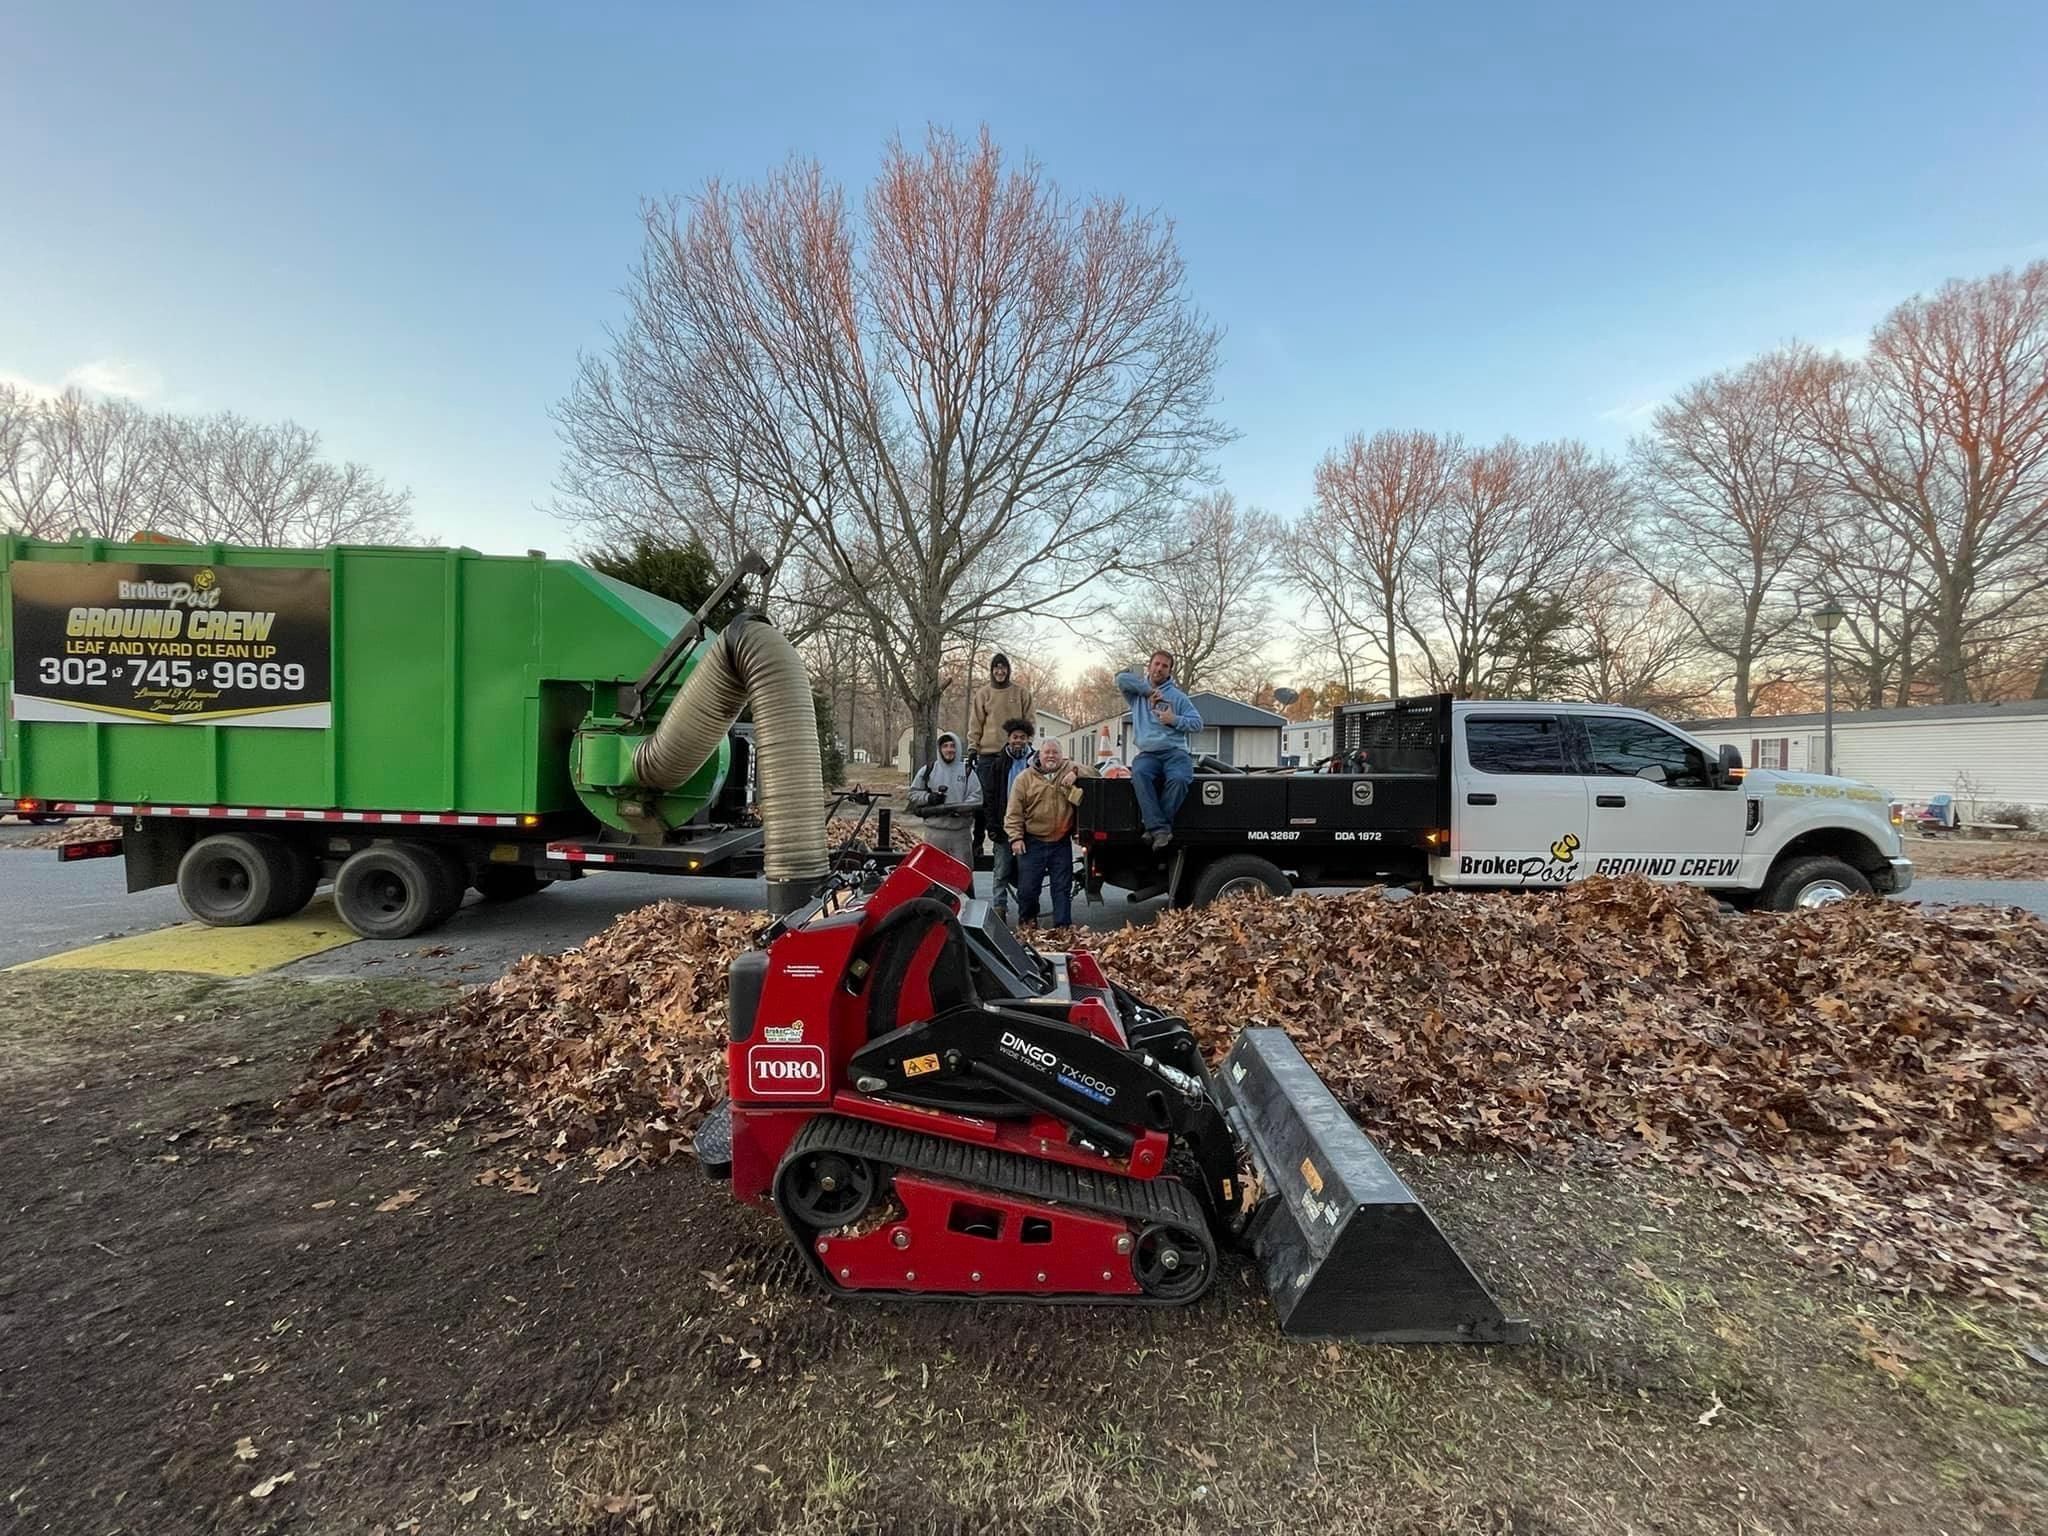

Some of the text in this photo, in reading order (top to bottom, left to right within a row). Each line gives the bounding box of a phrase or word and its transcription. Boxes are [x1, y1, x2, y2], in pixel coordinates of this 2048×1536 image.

[66, 607, 276, 641] GROUND CREW
[66, 640, 277, 659] LEAF AND YARD CLEAN UP
[39, 657, 305, 691] 302 745 9669
[1596, 858, 1740, 877] GROUND CREW
[1000, 1031, 1057, 1067] DINGO
[1000, 1045, 1048, 1073] WIDE TRACK
